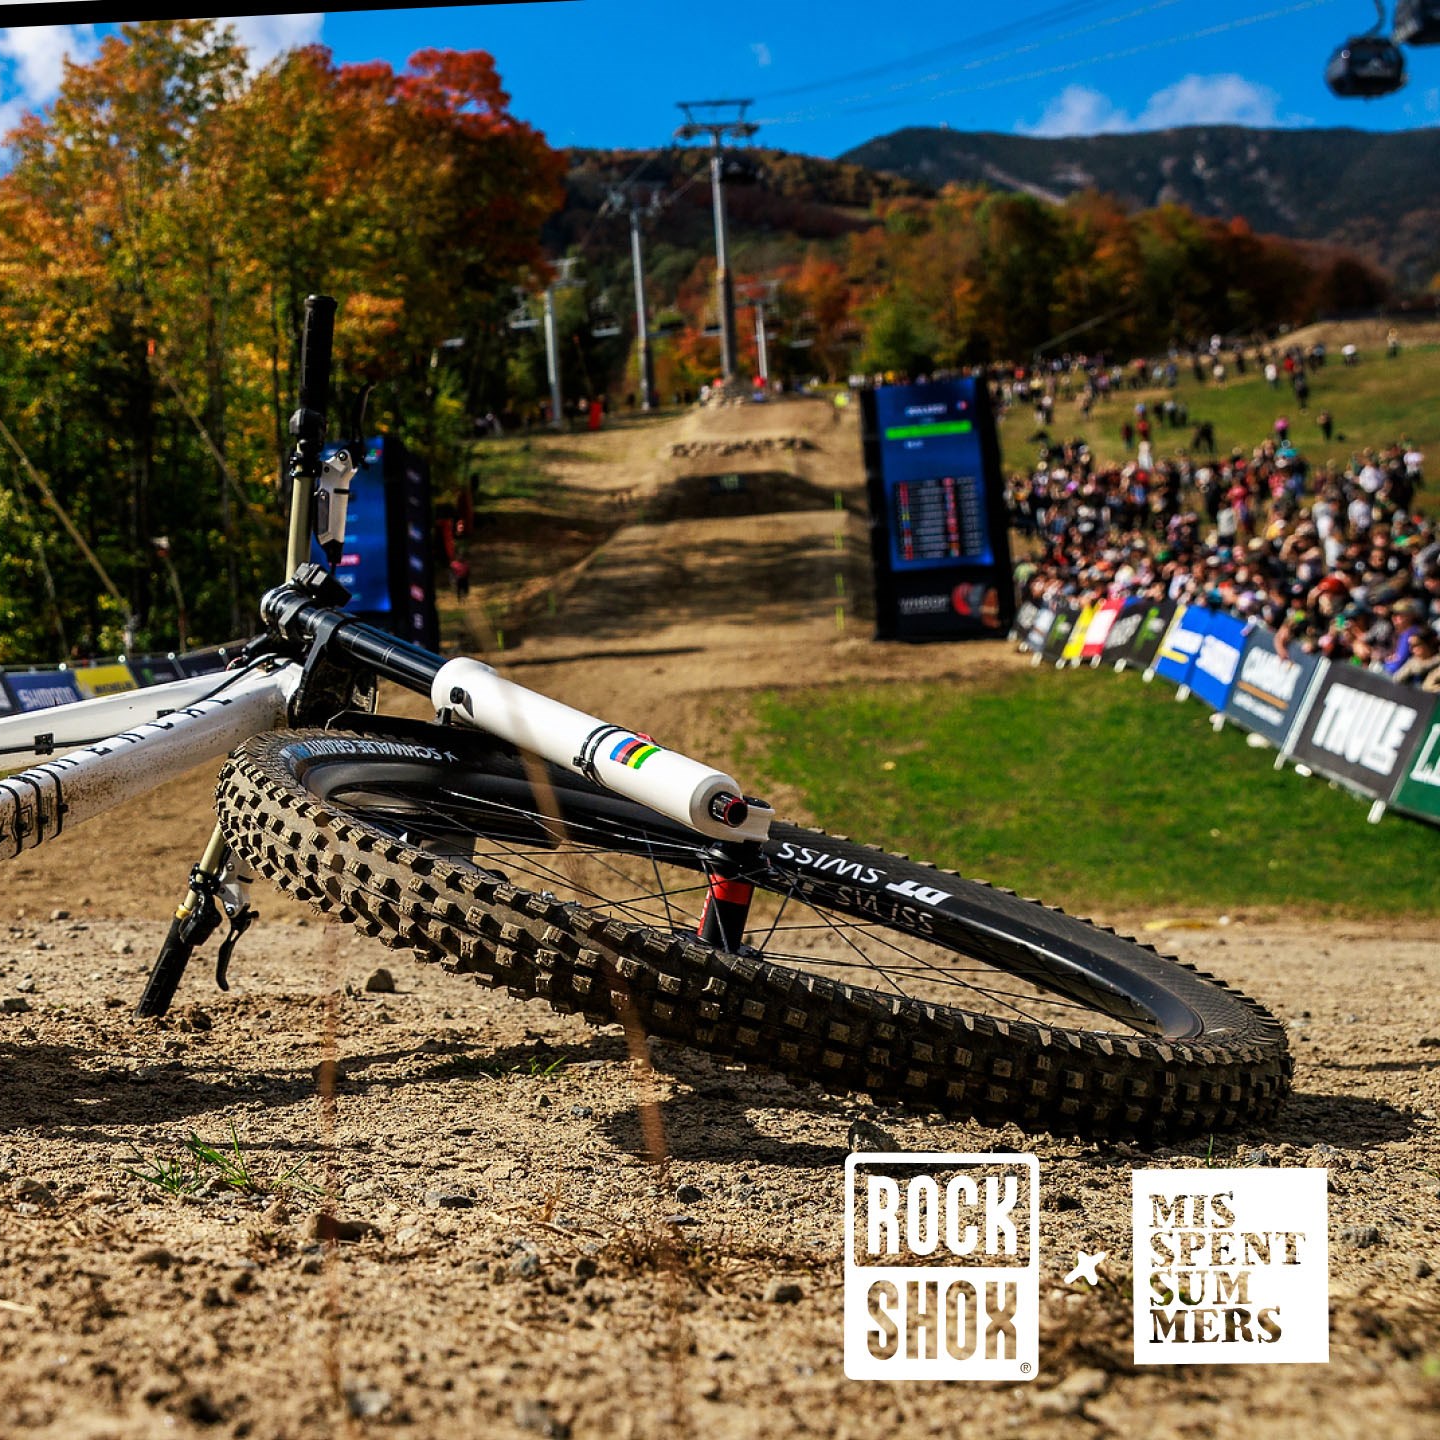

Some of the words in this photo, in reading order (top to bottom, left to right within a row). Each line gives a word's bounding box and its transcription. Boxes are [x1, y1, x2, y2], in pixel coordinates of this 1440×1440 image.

[1312, 682, 1418, 776] THULE
[303, 739, 355, 756] GRAVITY
[354, 740, 443, 760] SCHWALBE
[777, 842, 888, 884] SWISS
[885, 880, 954, 906] DT
